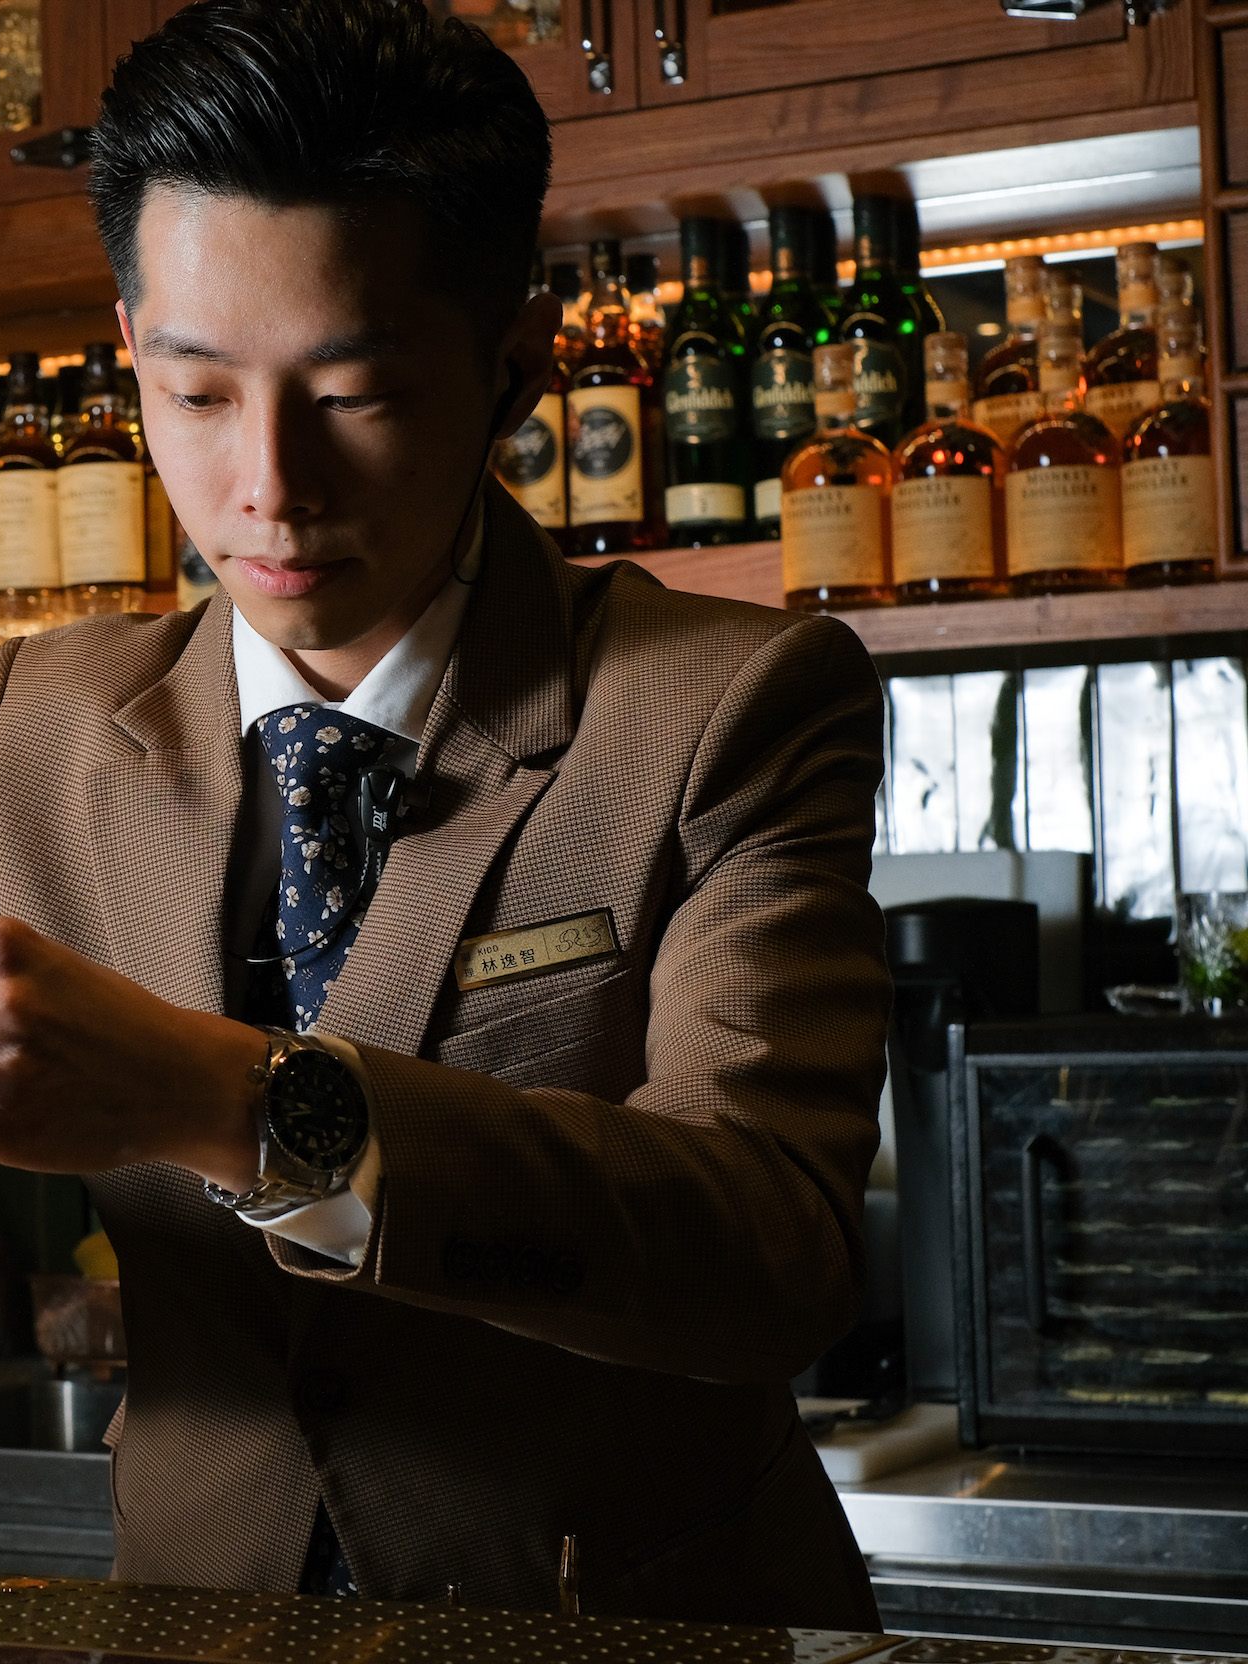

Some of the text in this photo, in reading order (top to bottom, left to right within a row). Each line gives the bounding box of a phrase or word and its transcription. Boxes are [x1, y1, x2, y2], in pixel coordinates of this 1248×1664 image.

[477, 944, 499, 956] KIDO
[481, 948, 535, 975] 林逸智
